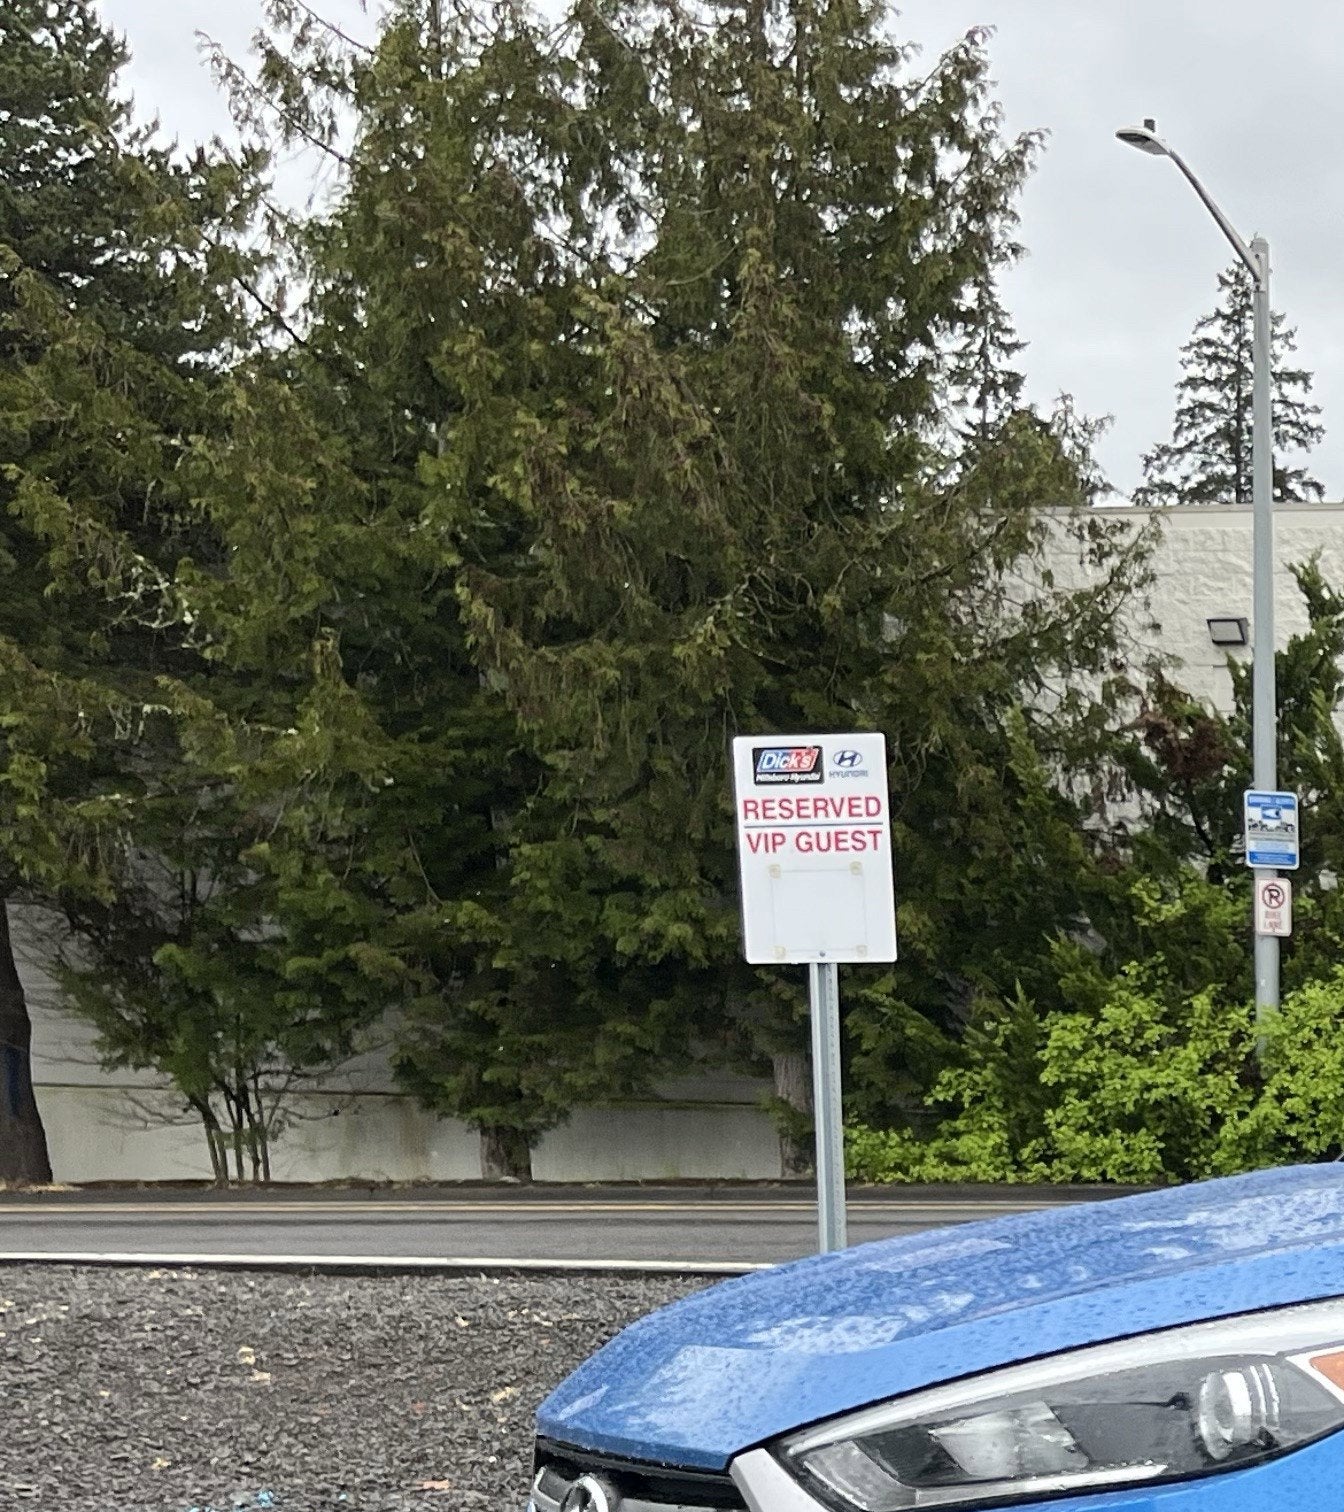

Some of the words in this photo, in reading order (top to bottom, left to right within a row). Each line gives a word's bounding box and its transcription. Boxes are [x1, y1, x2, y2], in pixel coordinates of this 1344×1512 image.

[743, 797, 881, 820] RESERVED
[746, 832, 786, 854] VIP
[795, 830, 882, 852] GUEST
